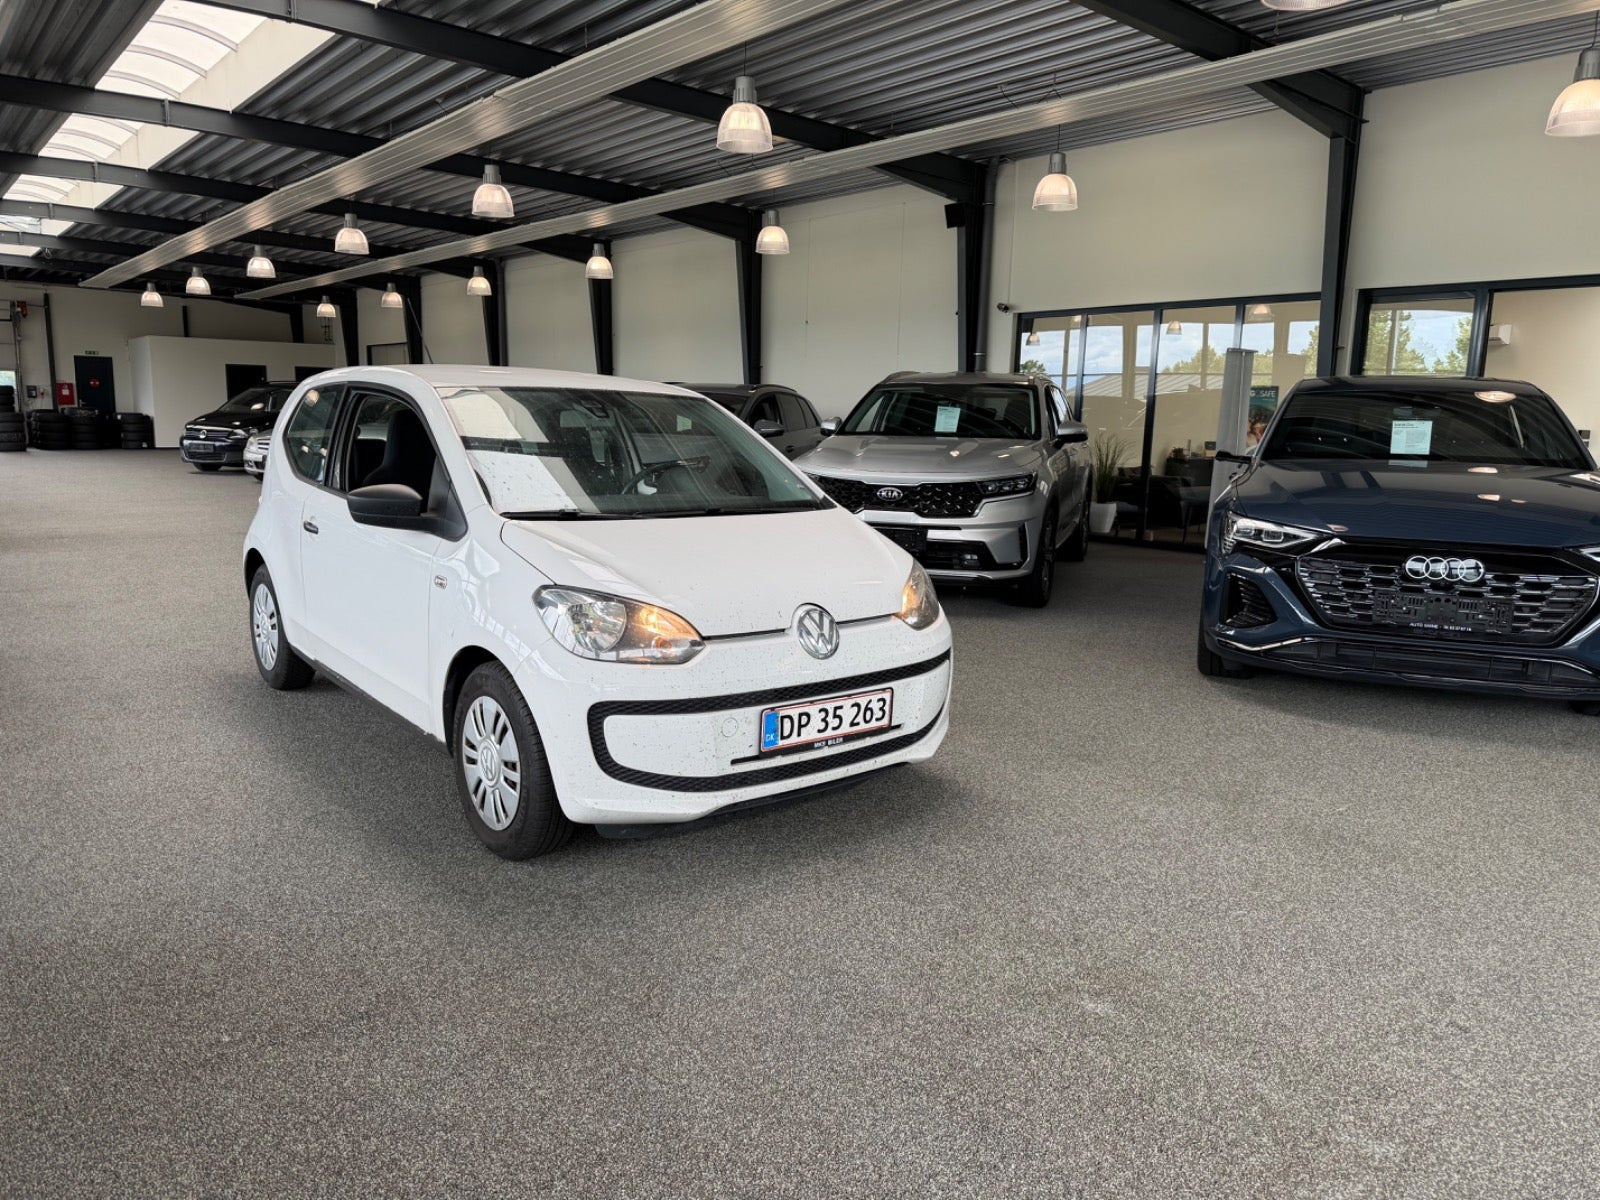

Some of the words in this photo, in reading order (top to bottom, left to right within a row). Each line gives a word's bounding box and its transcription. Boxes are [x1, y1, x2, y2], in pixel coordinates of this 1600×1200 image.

[881, 490, 899, 499] KIA
[780, 712, 811, 741] DP
[816, 705, 844, 734] 35
[848, 697, 887, 728] 263
[765, 732, 775, 741] DK
